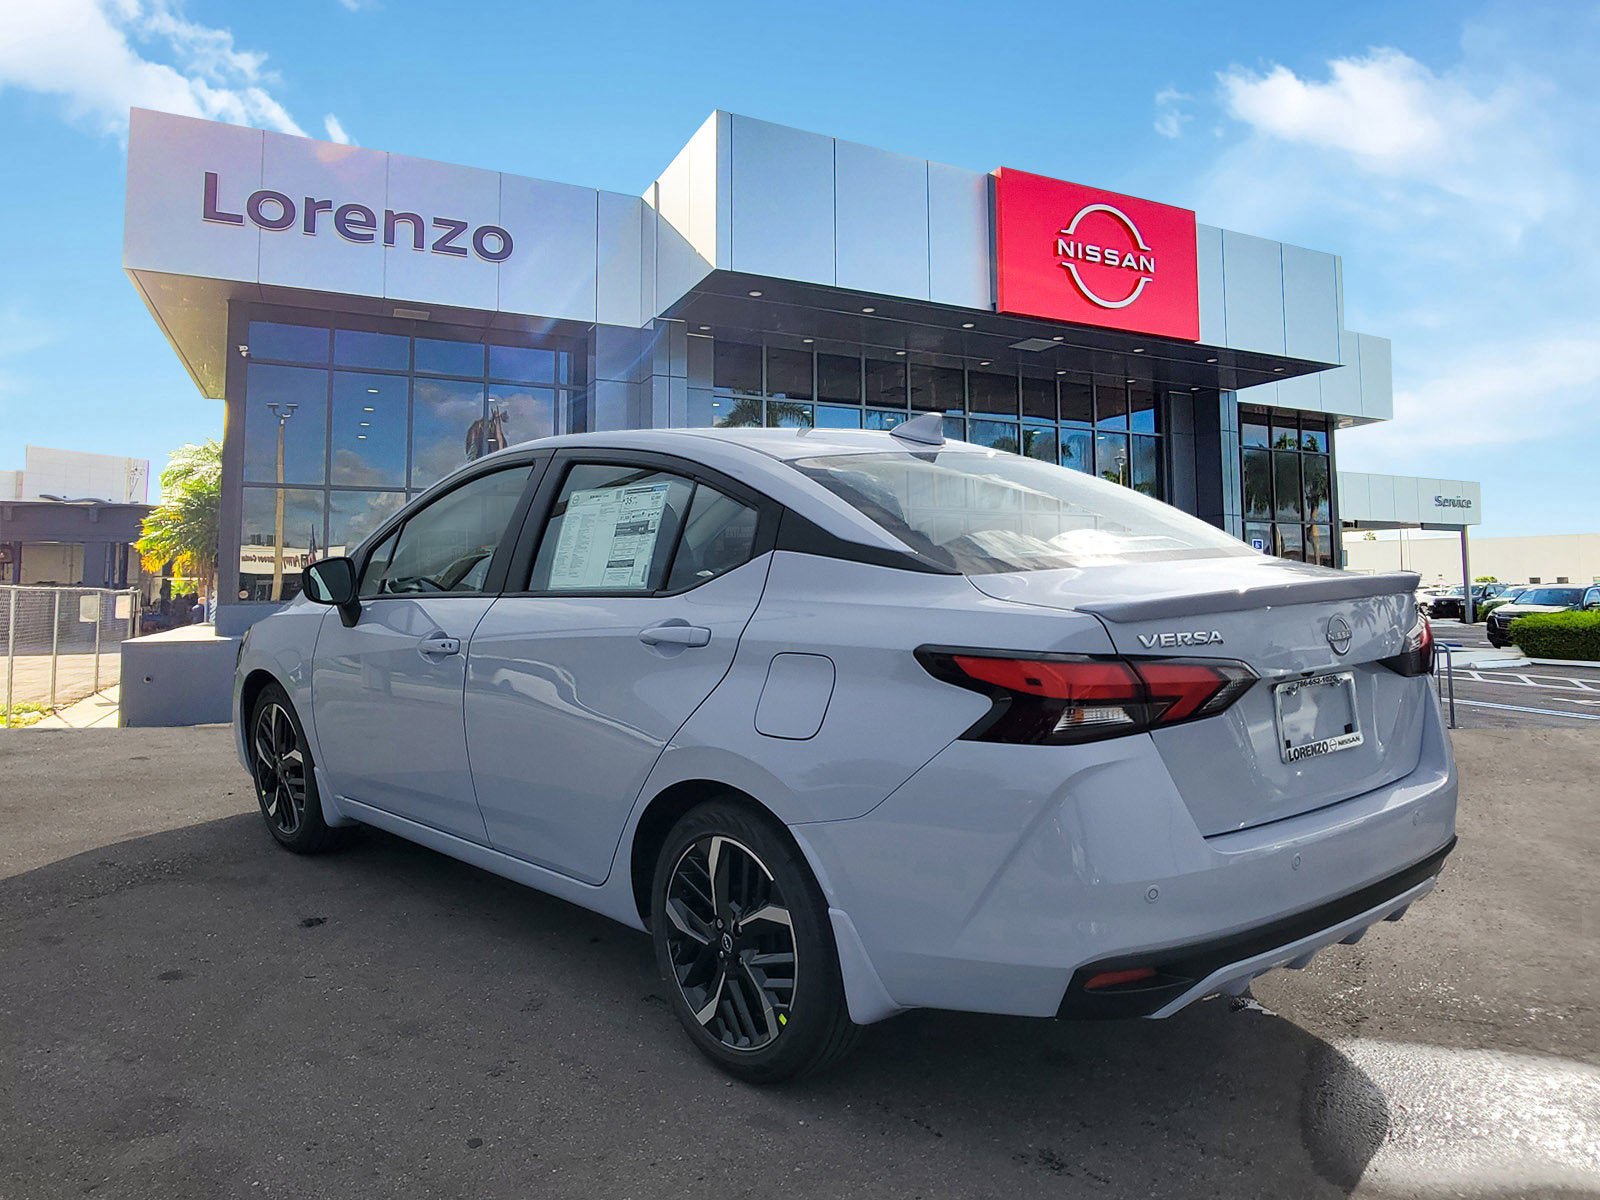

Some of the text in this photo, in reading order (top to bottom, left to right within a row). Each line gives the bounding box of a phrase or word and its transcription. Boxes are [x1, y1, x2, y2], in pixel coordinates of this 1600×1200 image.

[202, 171, 515, 262] Lorenzo
[1057, 238, 1155, 273] NISSAN
[1434, 495, 1472, 509] Service
[1137, 630, 1224, 648] VERSA
[1288, 736, 1361, 762] LORENZO NISSAN
